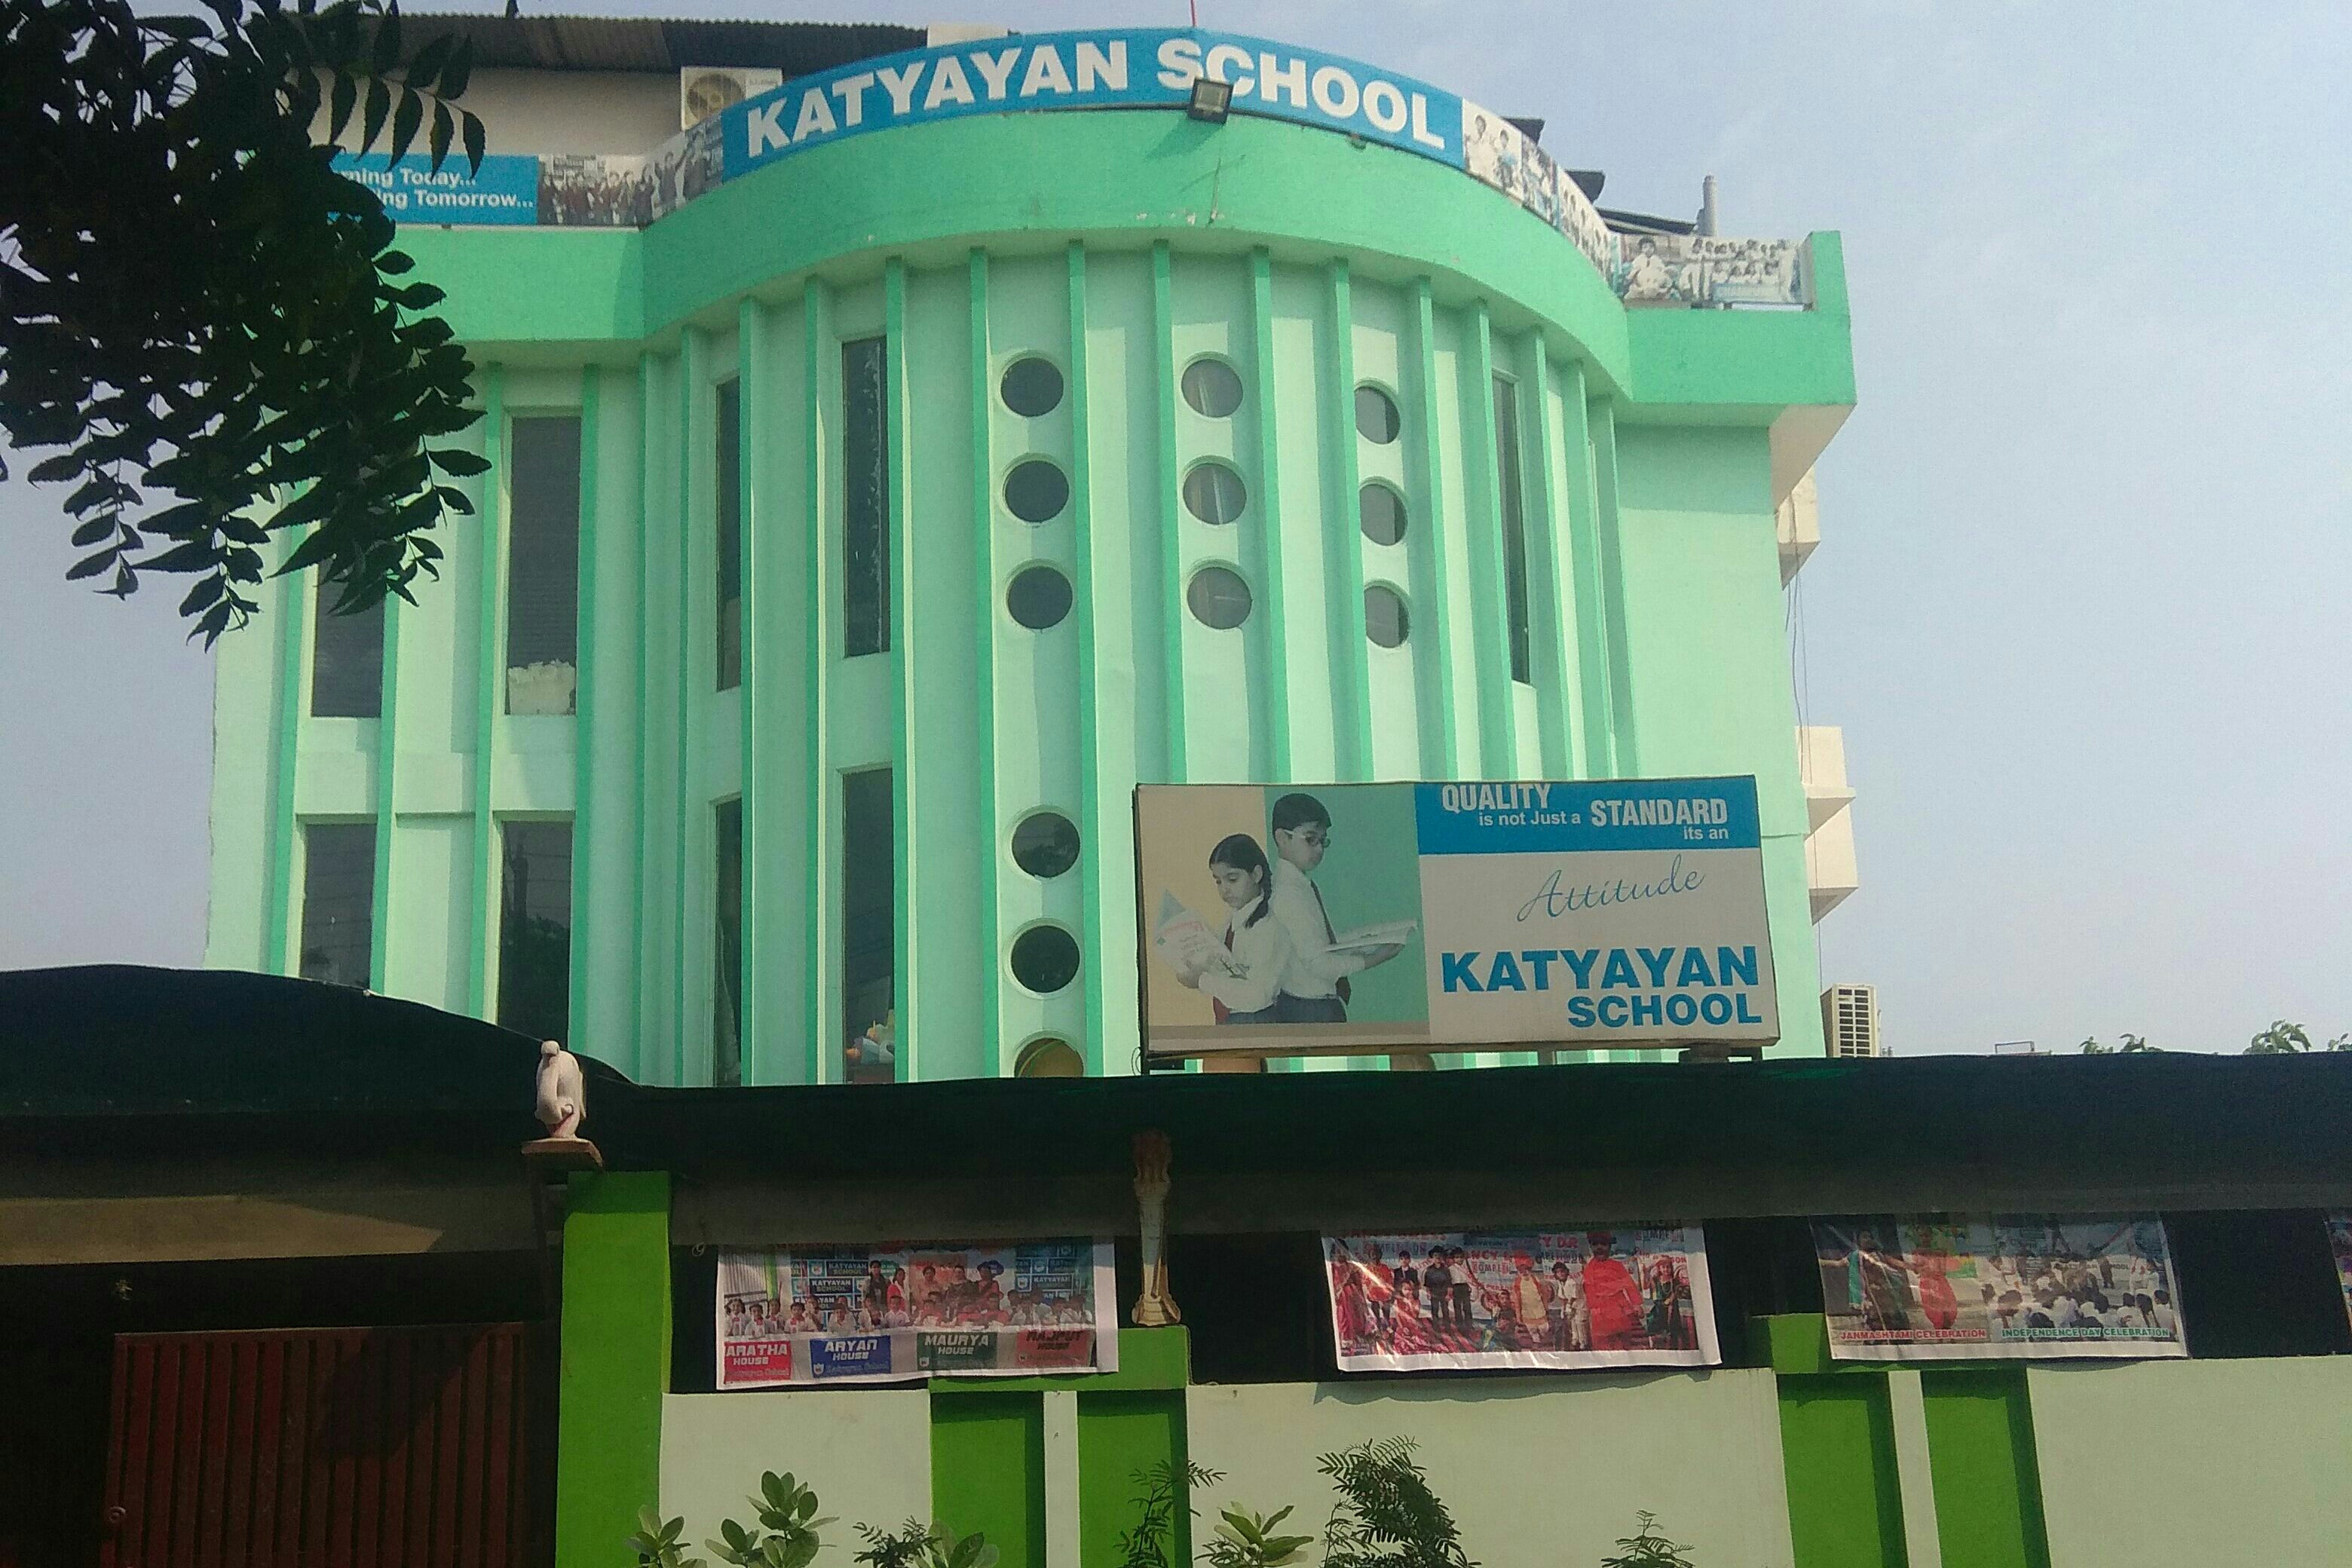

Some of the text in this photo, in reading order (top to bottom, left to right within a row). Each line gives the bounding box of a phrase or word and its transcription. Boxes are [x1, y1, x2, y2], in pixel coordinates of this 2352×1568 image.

[746, 38, 1446, 158] KATYAYAN SCHOOL
[415, 188, 534, 208] Tomorrow...
[1441, 783, 1551, 814] QUALITY
[1479, 798, 1728, 827] is not Just a STANDARD
[1683, 826, 1729, 841] its an
[1515, 853, 1706, 921] Attitude
[1441, 946, 1759, 993] KATYAYAN
[1567, 993, 1762, 1027] SCHOOL
[924, 1334, 989, 1347] MAURYA
[1840, 1328, 1986, 1340] JANMASHTAMI CELEBRATION
[2001, 1327, 2170, 1338] INDEPENDENCE DAY CELEBRATION
[832, 1352, 869, 1361] HOUSE
[937, 1346, 975, 1355] HOUSE
[733, 1356, 769, 1366] HOUSE
